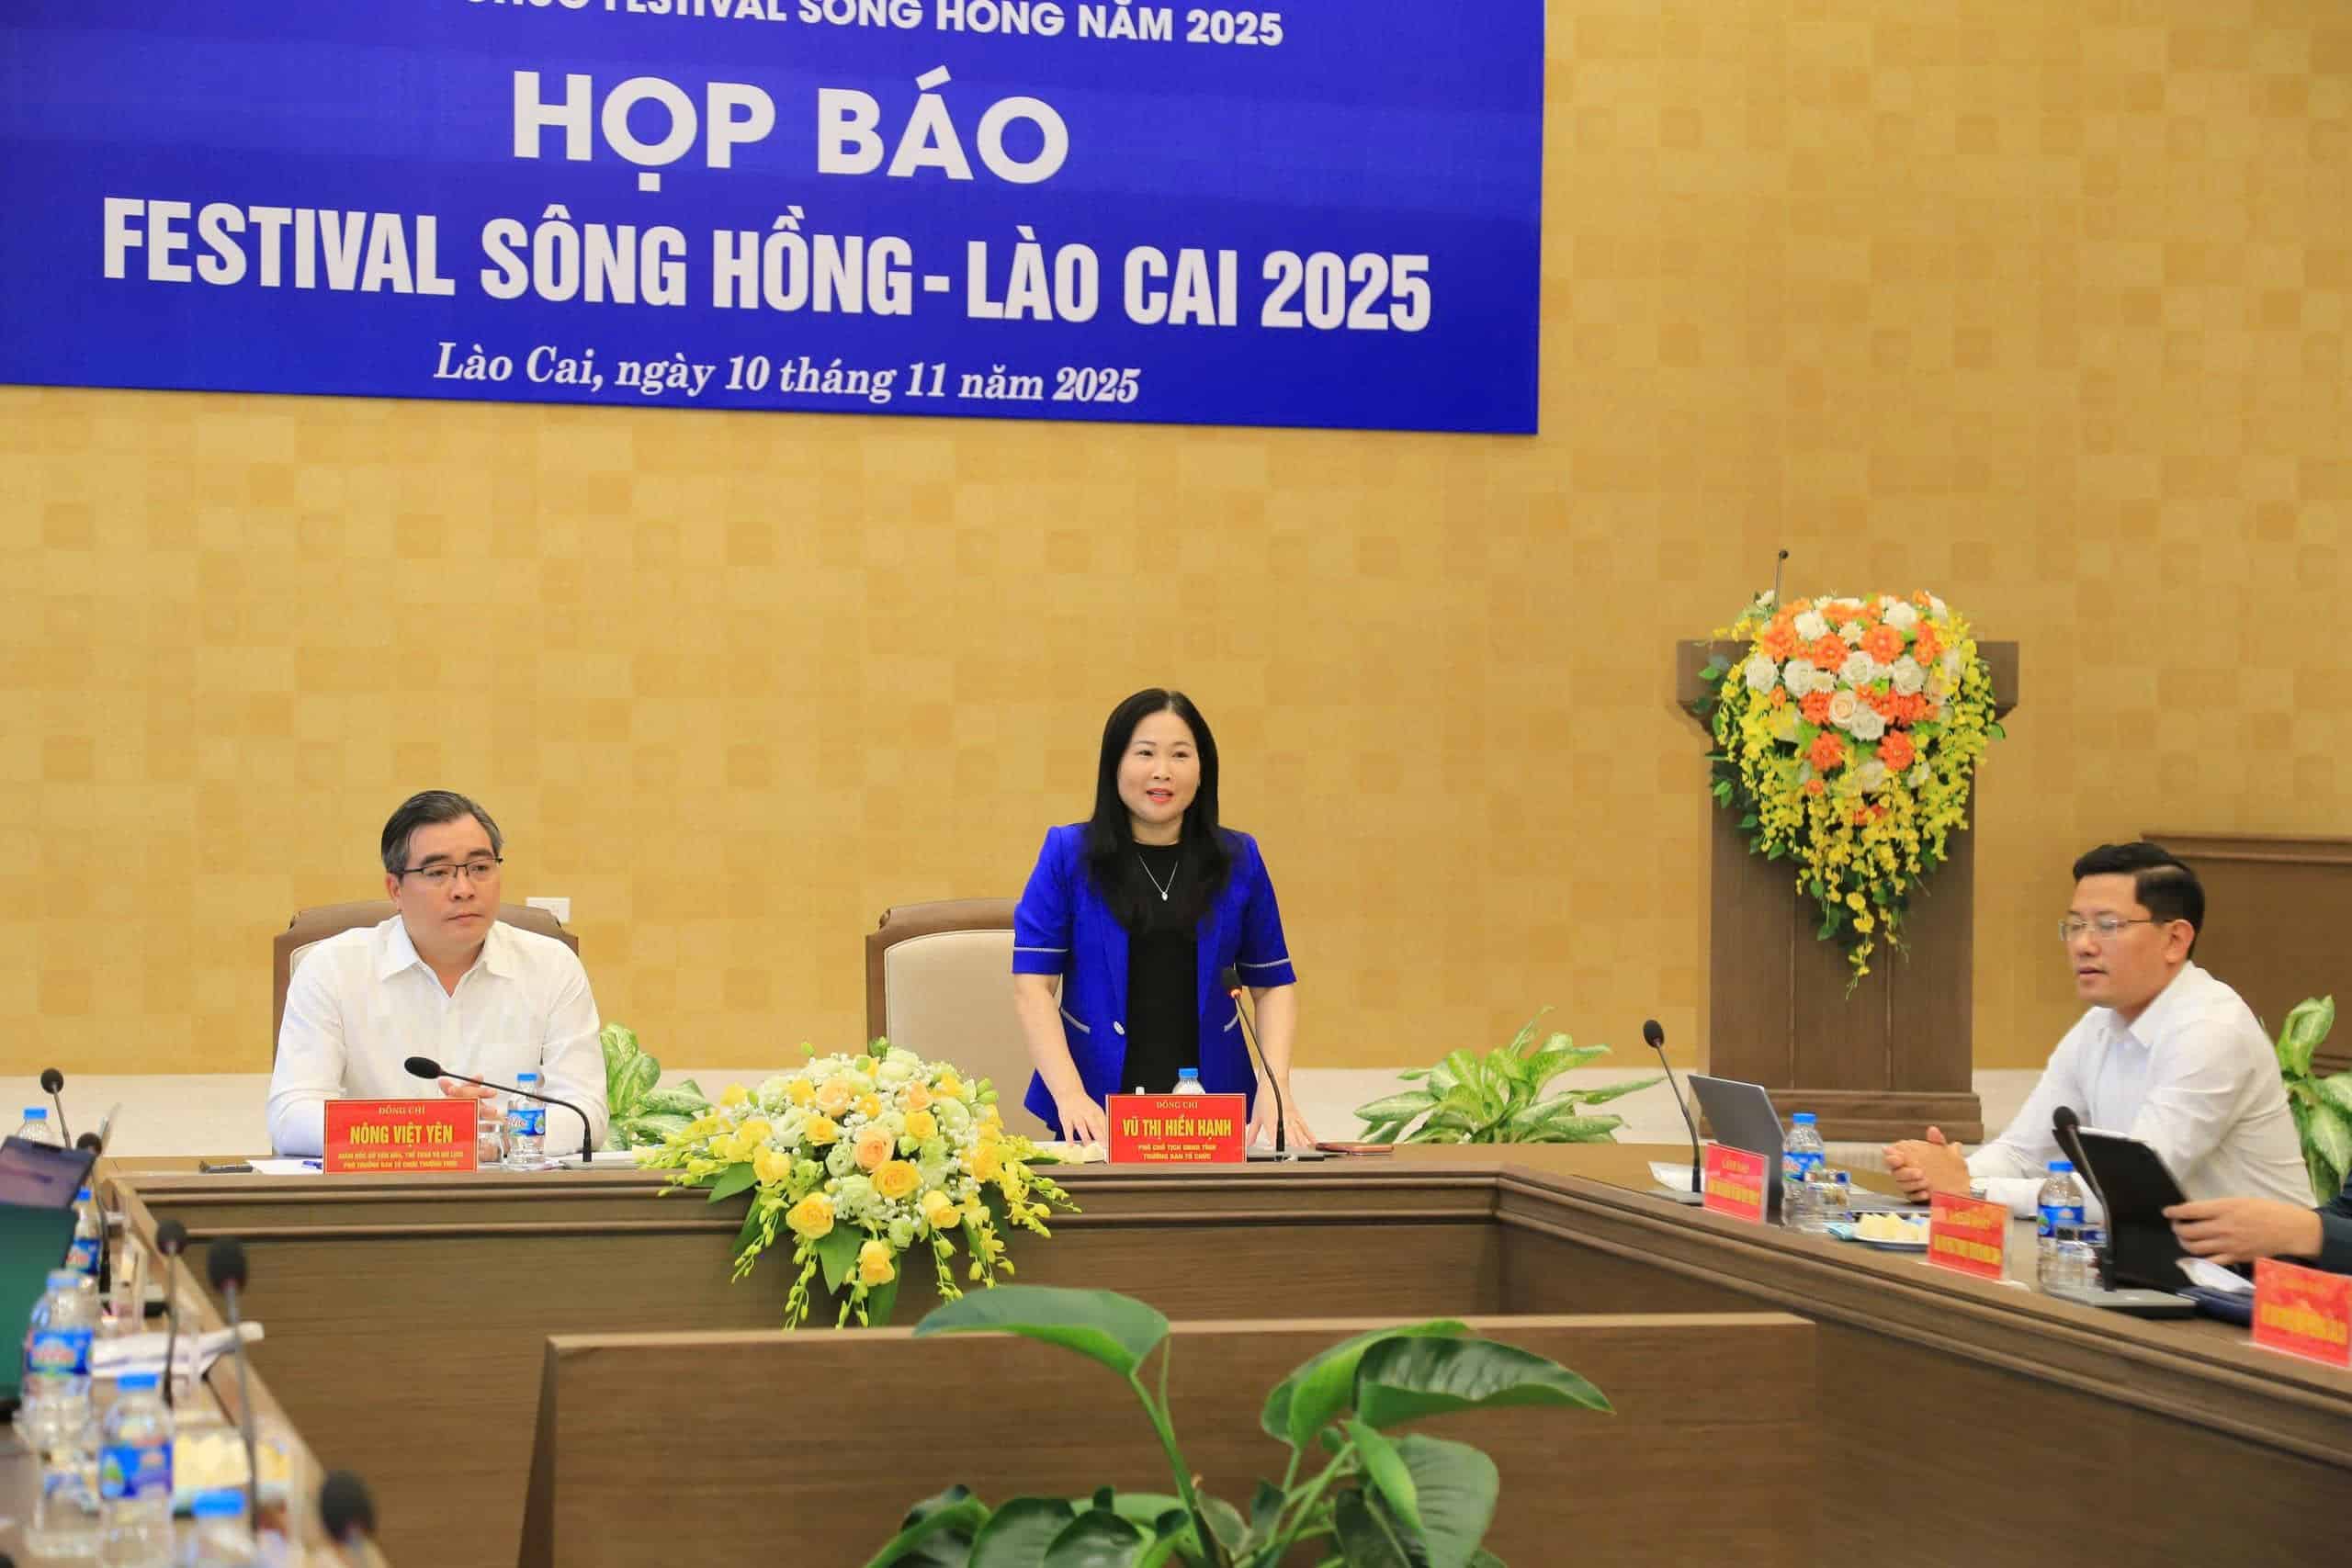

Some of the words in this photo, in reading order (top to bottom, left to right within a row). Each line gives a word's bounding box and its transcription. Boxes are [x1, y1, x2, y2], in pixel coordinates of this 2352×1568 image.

[1078, 0, 1173, 41] NĂM
[1186, 8, 1283, 46] 2025
[513, 70, 776, 192] HỌP
[817, 65, 1069, 184] BÁO
[104, 197, 456, 296] FESTIVAL
[481, 204, 686, 306] SÔNG
[713, 205, 912, 315] HỒNG
[967, 225, 1099, 322] LÀO
[1124, 245, 1238, 326] CAI
[1261, 250, 1431, 332] 2025
[433, 342, 514, 381] Lào
[526, 345, 604, 392] Cai,
[615, 352, 717, 397] ngày
[725, 355, 770, 390] 10
[780, 356, 898, 404] tháng
[905, 362, 946, 397] 11
[958, 364, 1044, 400] năm
[1052, 367, 1141, 403] 2025
[350, 1122, 389, 1145] NÔNG
[393, 1122, 423, 1147] VIỆT
[426, 1122, 453, 1144] YÊN
[1143, 1119, 1162, 1140] THỊ
[1198, 1119, 1232, 1140] HẠNH
